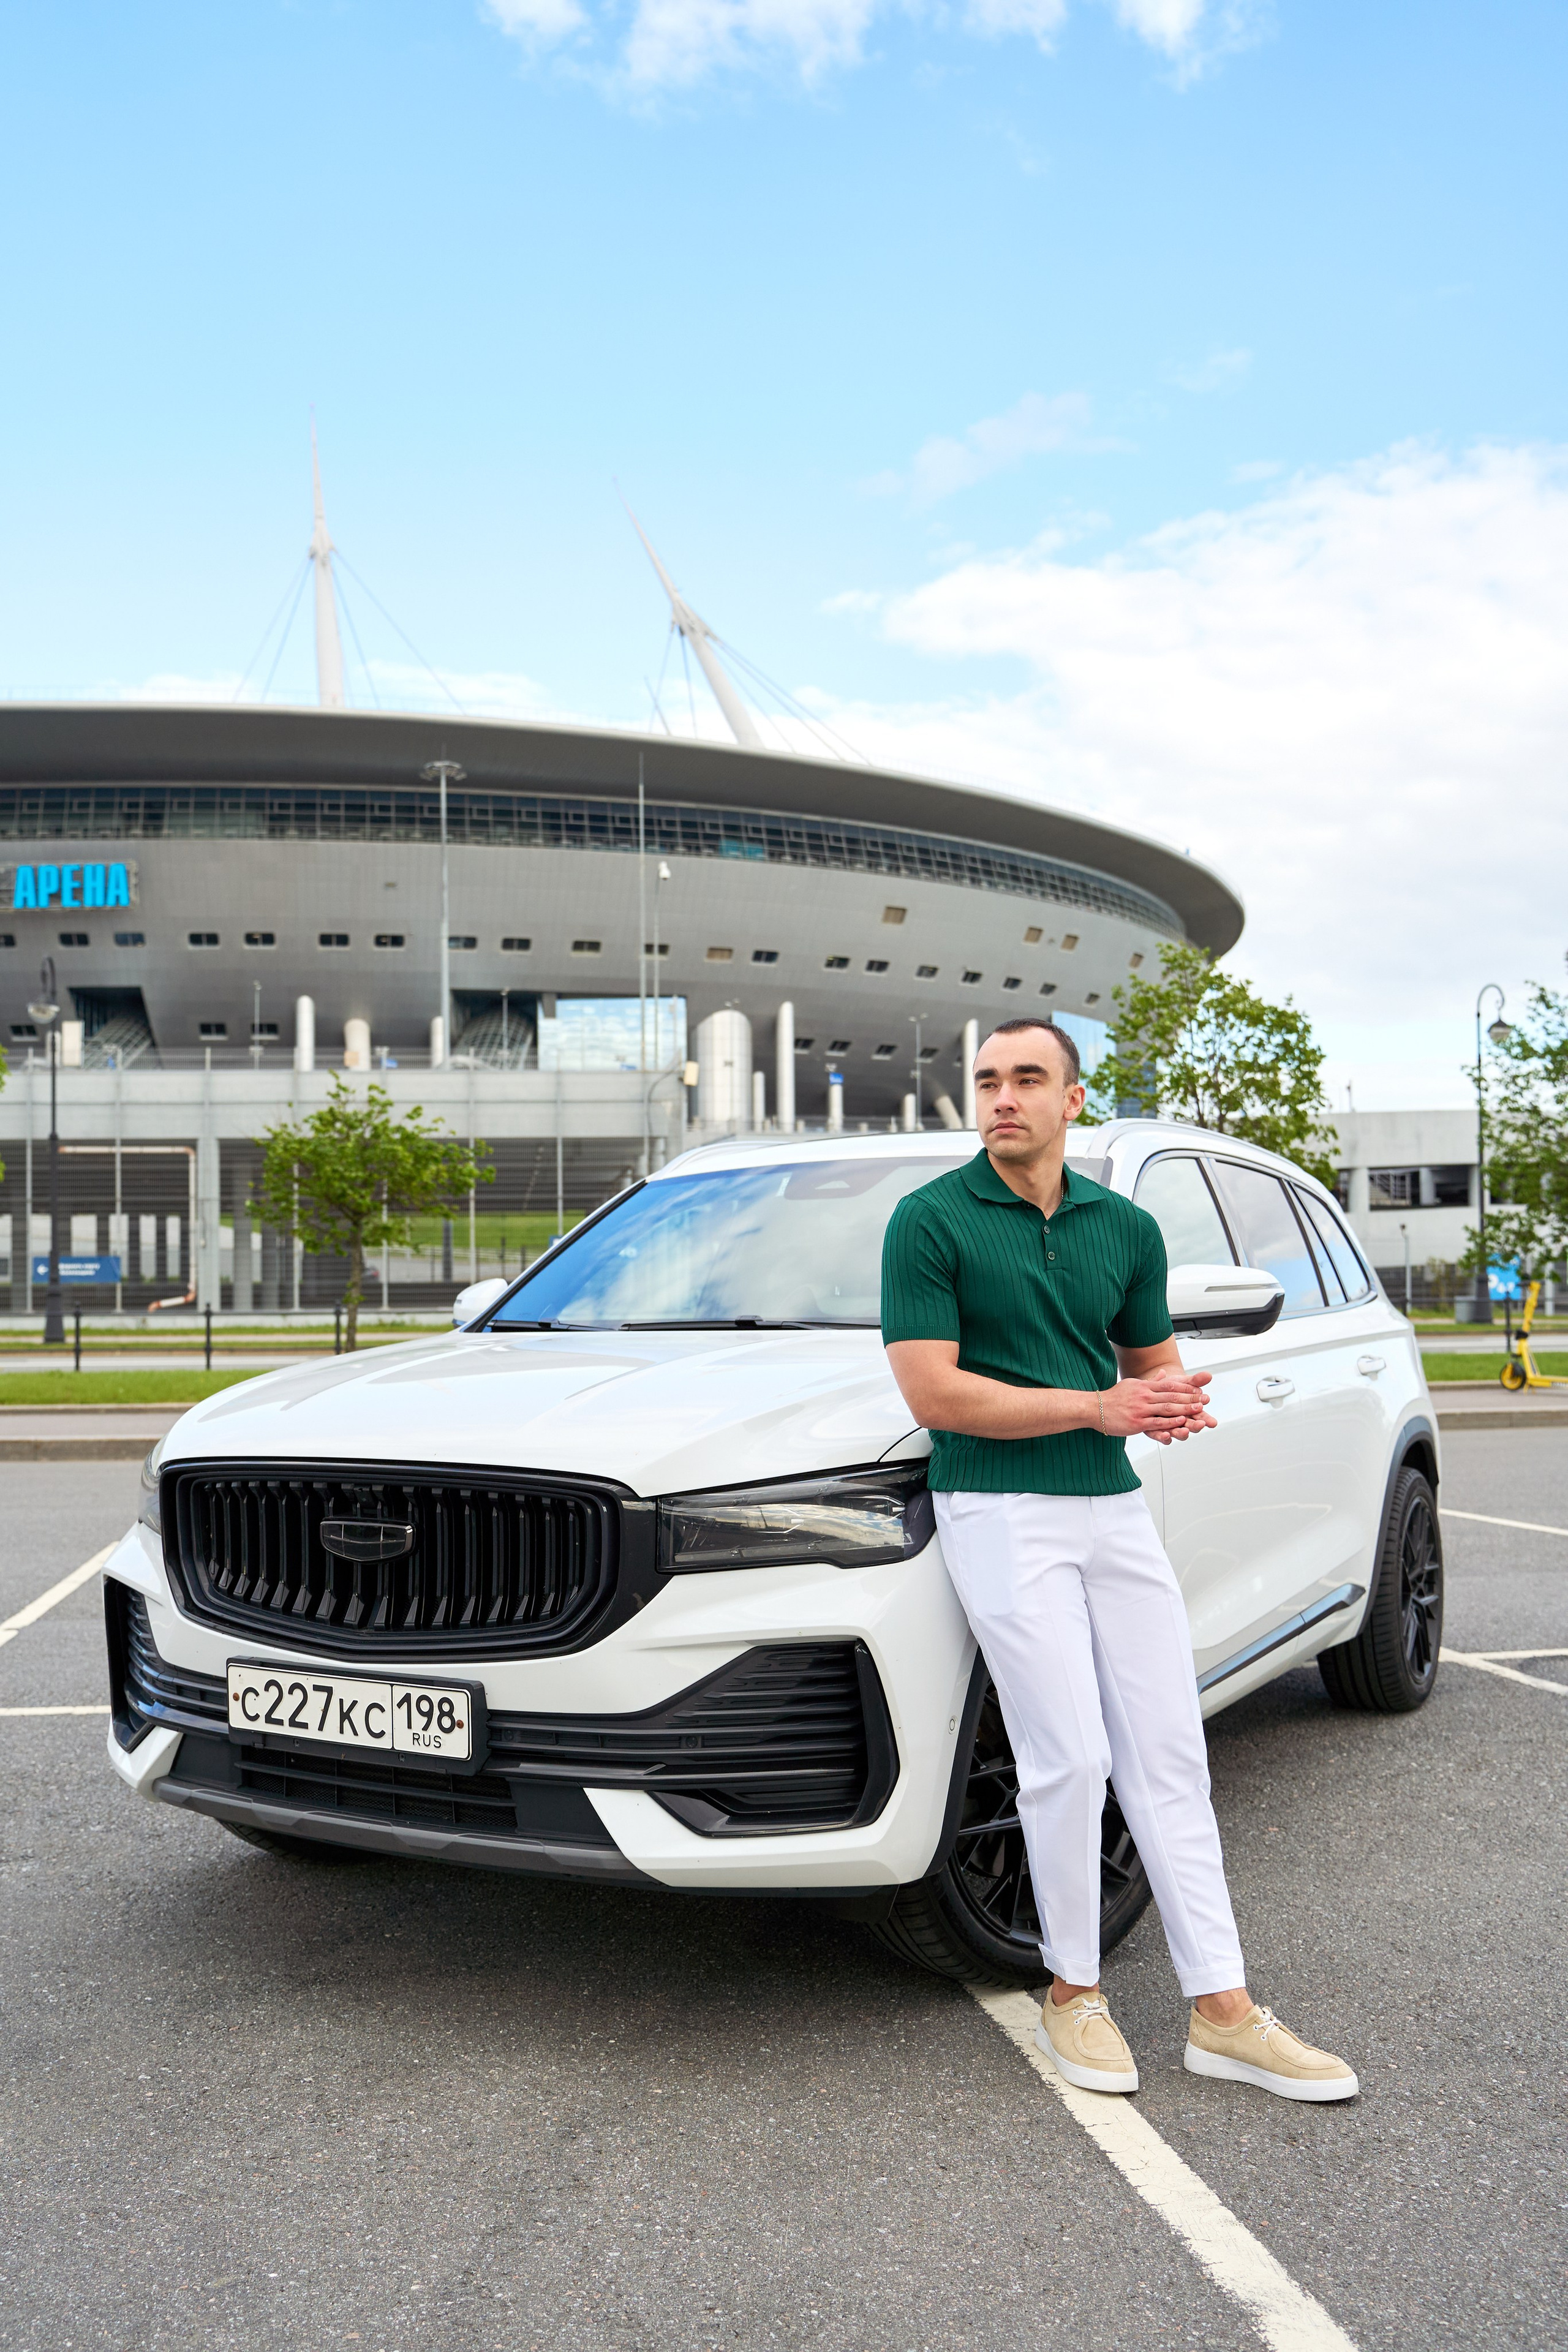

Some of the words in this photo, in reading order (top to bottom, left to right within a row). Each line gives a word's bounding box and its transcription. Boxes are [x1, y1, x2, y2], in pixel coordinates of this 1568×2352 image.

[13, 863, 130, 909] АРЕНА
[396, 1692, 456, 1733] 198
[412, 1732, 442, 1748] RUS
